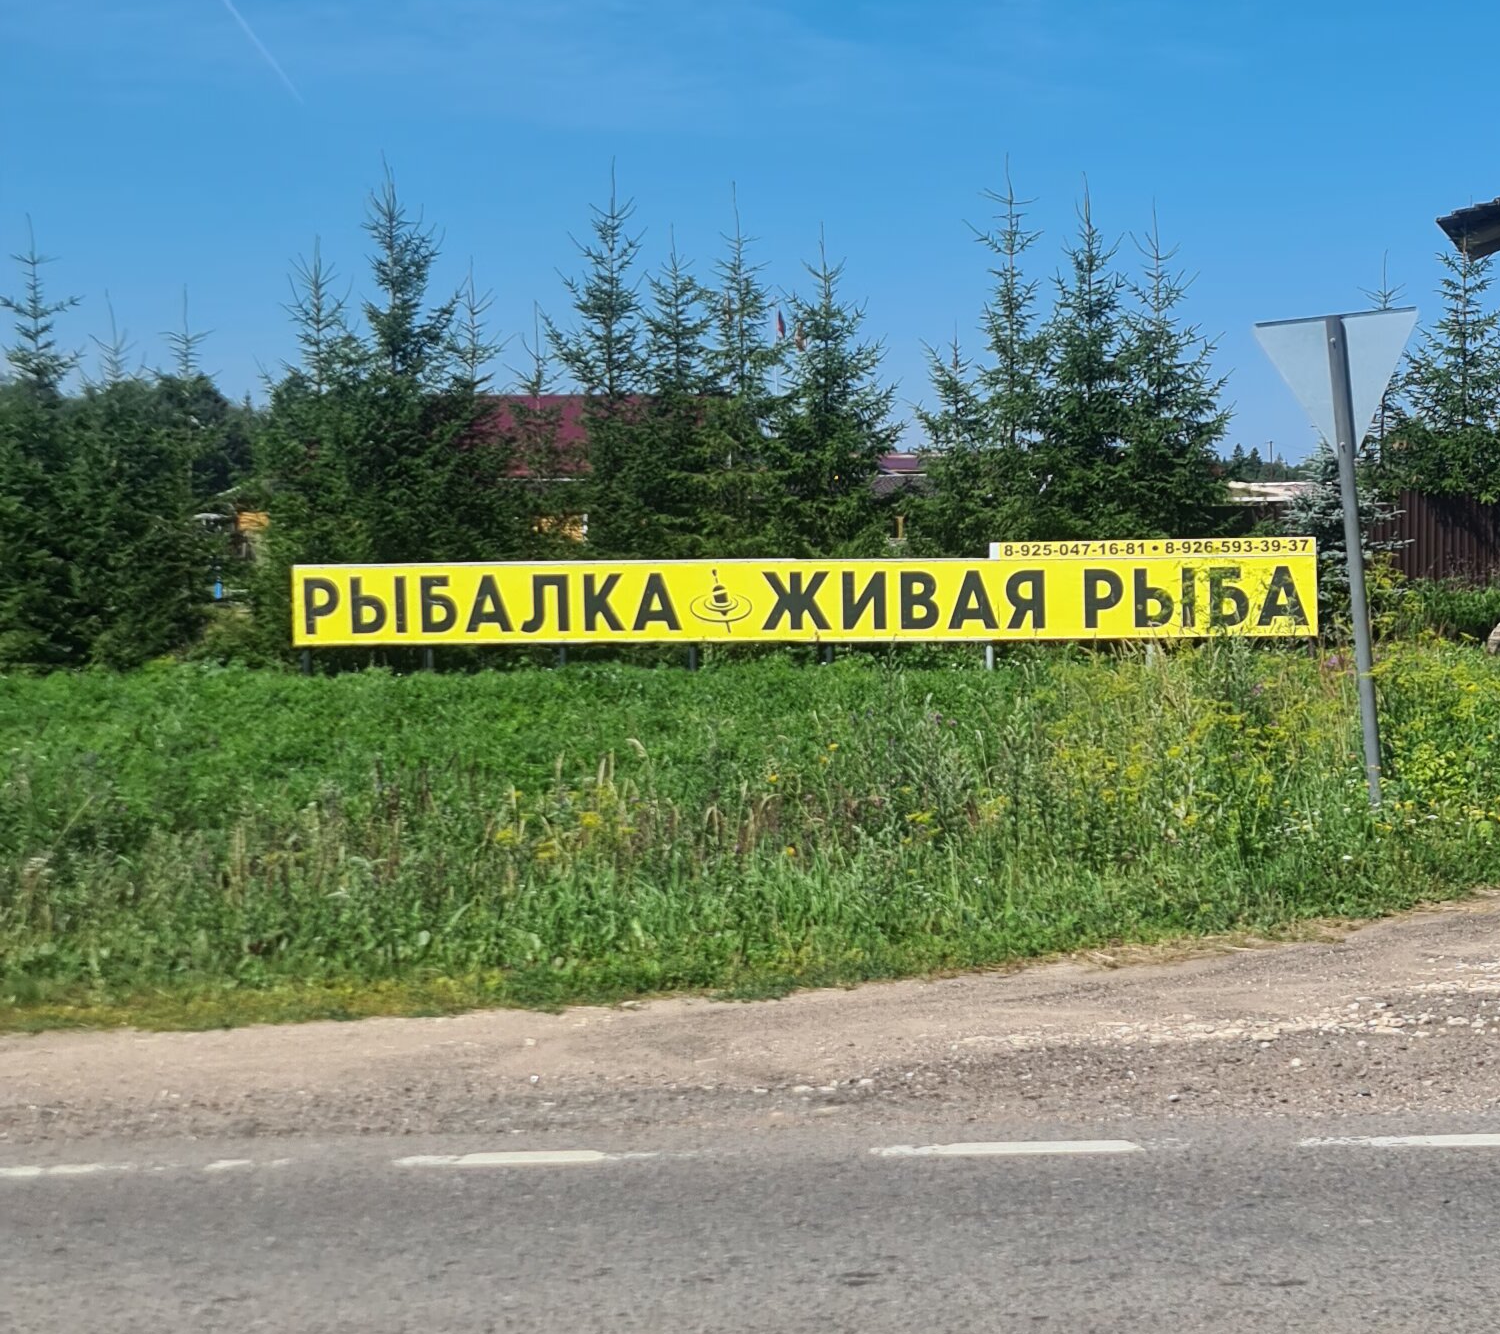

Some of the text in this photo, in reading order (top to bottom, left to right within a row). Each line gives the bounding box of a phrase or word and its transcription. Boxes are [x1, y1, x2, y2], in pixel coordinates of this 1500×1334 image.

[1003, 538, 1310, 557] 8-925-047-16-81 8-926-593-39-37
[303, 565, 1310, 635] РЫБАЛКА ЖИВАЯ РЫБА
